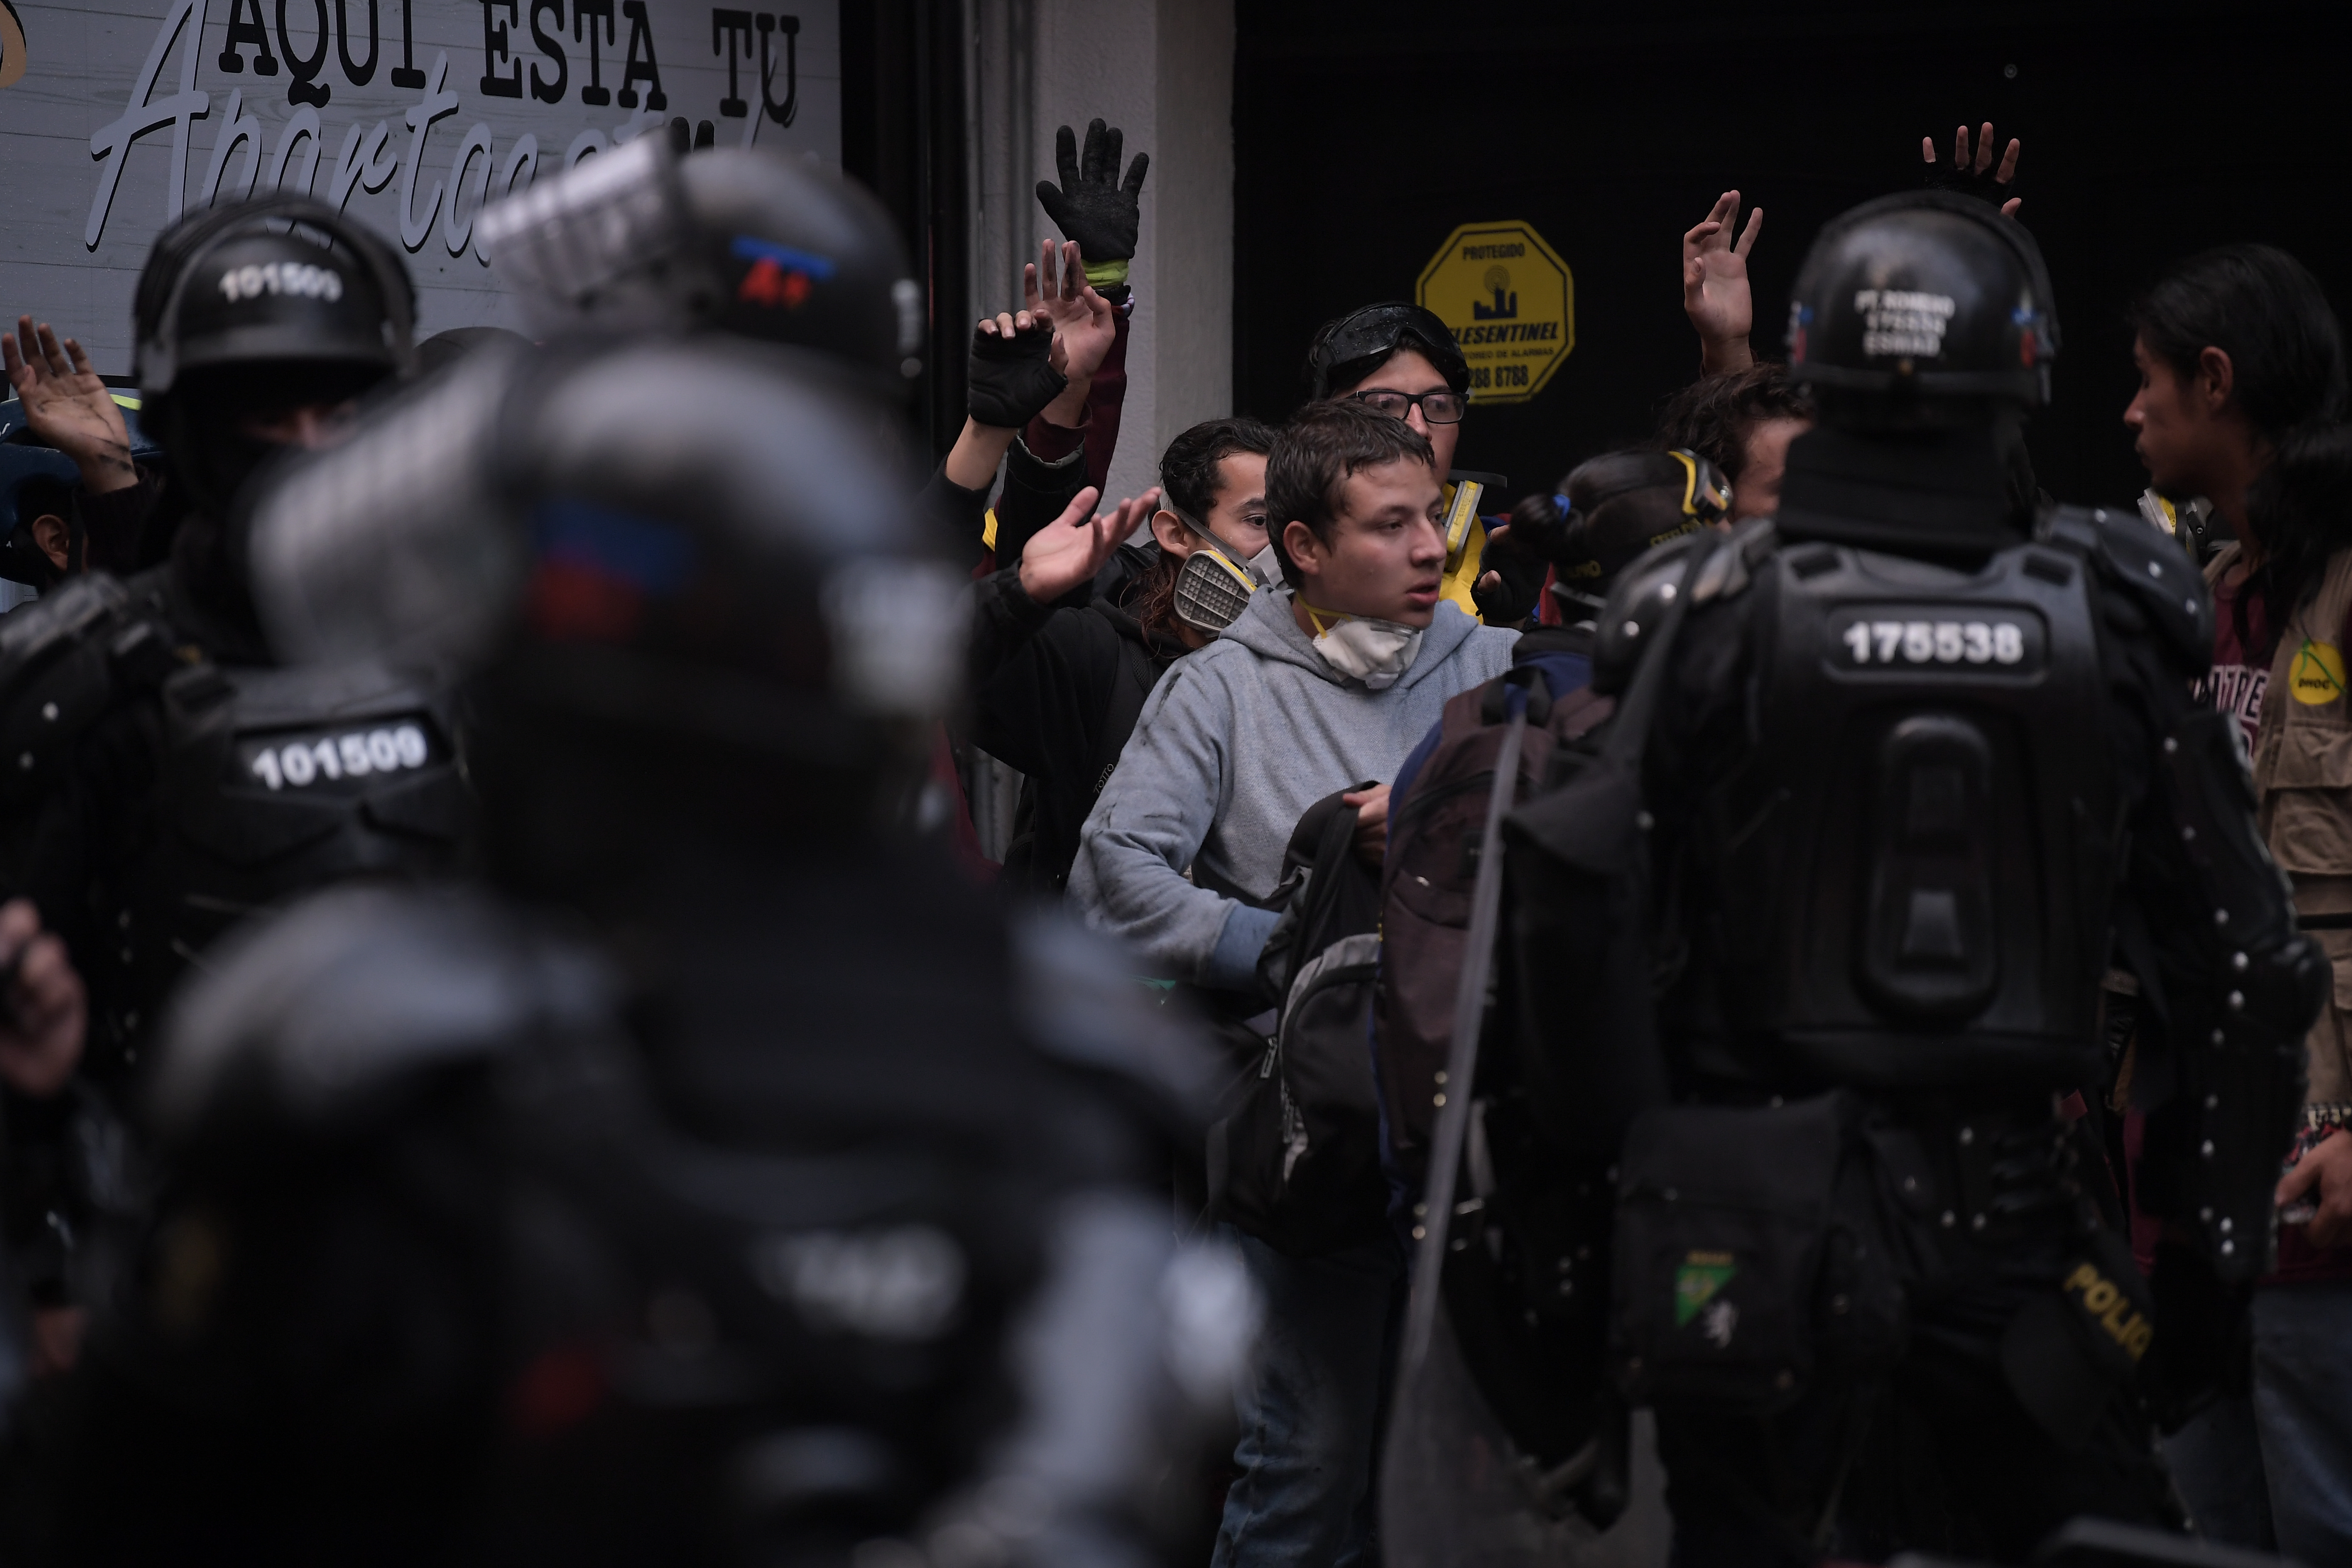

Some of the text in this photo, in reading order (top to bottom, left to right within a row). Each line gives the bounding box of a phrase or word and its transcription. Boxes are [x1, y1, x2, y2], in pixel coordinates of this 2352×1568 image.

[712, 8, 800, 125] TU
[1462, 243, 1526, 261] PROTEGIDO
[1450, 321, 1559, 345] LESENTINEL
[1497, 350, 1508, 358] DE
[1511, 348, 1554, 357] ALARMAS
[1495, 365, 1528, 388] 8788
[1843, 621, 2024, 665] 175538
[253, 724, 427, 791] 101509
[1093, 763, 1114, 794] TOTTO
[2061, 1262, 2153, 1363] POLIC
